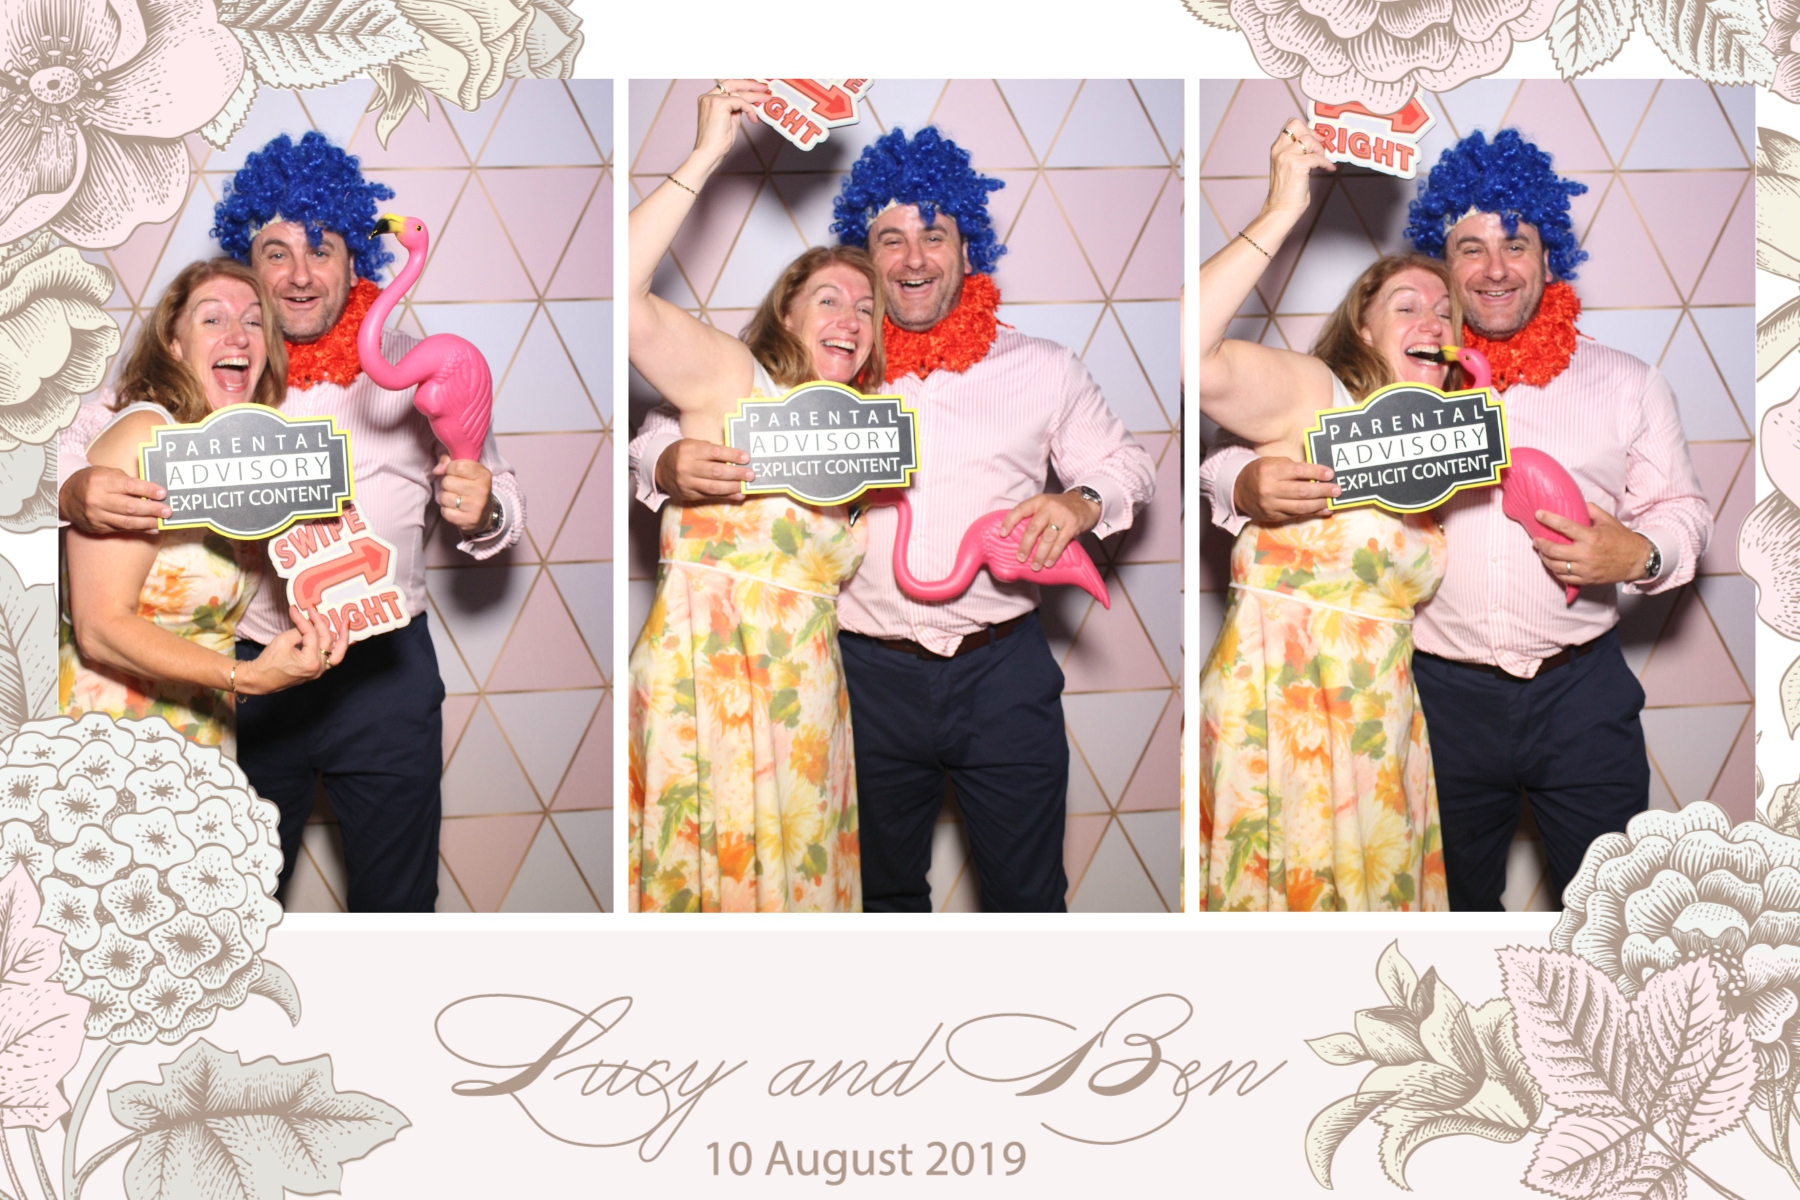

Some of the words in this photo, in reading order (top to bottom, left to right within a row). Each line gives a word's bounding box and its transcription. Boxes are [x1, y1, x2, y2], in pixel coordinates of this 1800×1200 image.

[752, 97, 823, 145] GHT
[1314, 122, 1415, 172] RIGHT
[750, 409, 898, 428] PARENTAL
[1329, 404, 1484, 440] PARENTAL
[165, 432, 328, 457] PARENTAL
[752, 430, 898, 454] ADVISORY
[1335, 426, 1485, 468] ADVISORY
[169, 455, 329, 486] ADVISORY
[753, 460, 821, 478] EXPLICIT
[825, 457, 900, 475] CONTENT
[1336, 466, 1408, 492] EXPLICIT
[1411, 454, 1489, 480] CONTENT
[169, 490, 245, 512] EXPLICIT
[249, 484, 331, 506] CONTENT
[274, 503, 367, 569] SWIPE
[317, 591, 403, 640] IGHT
